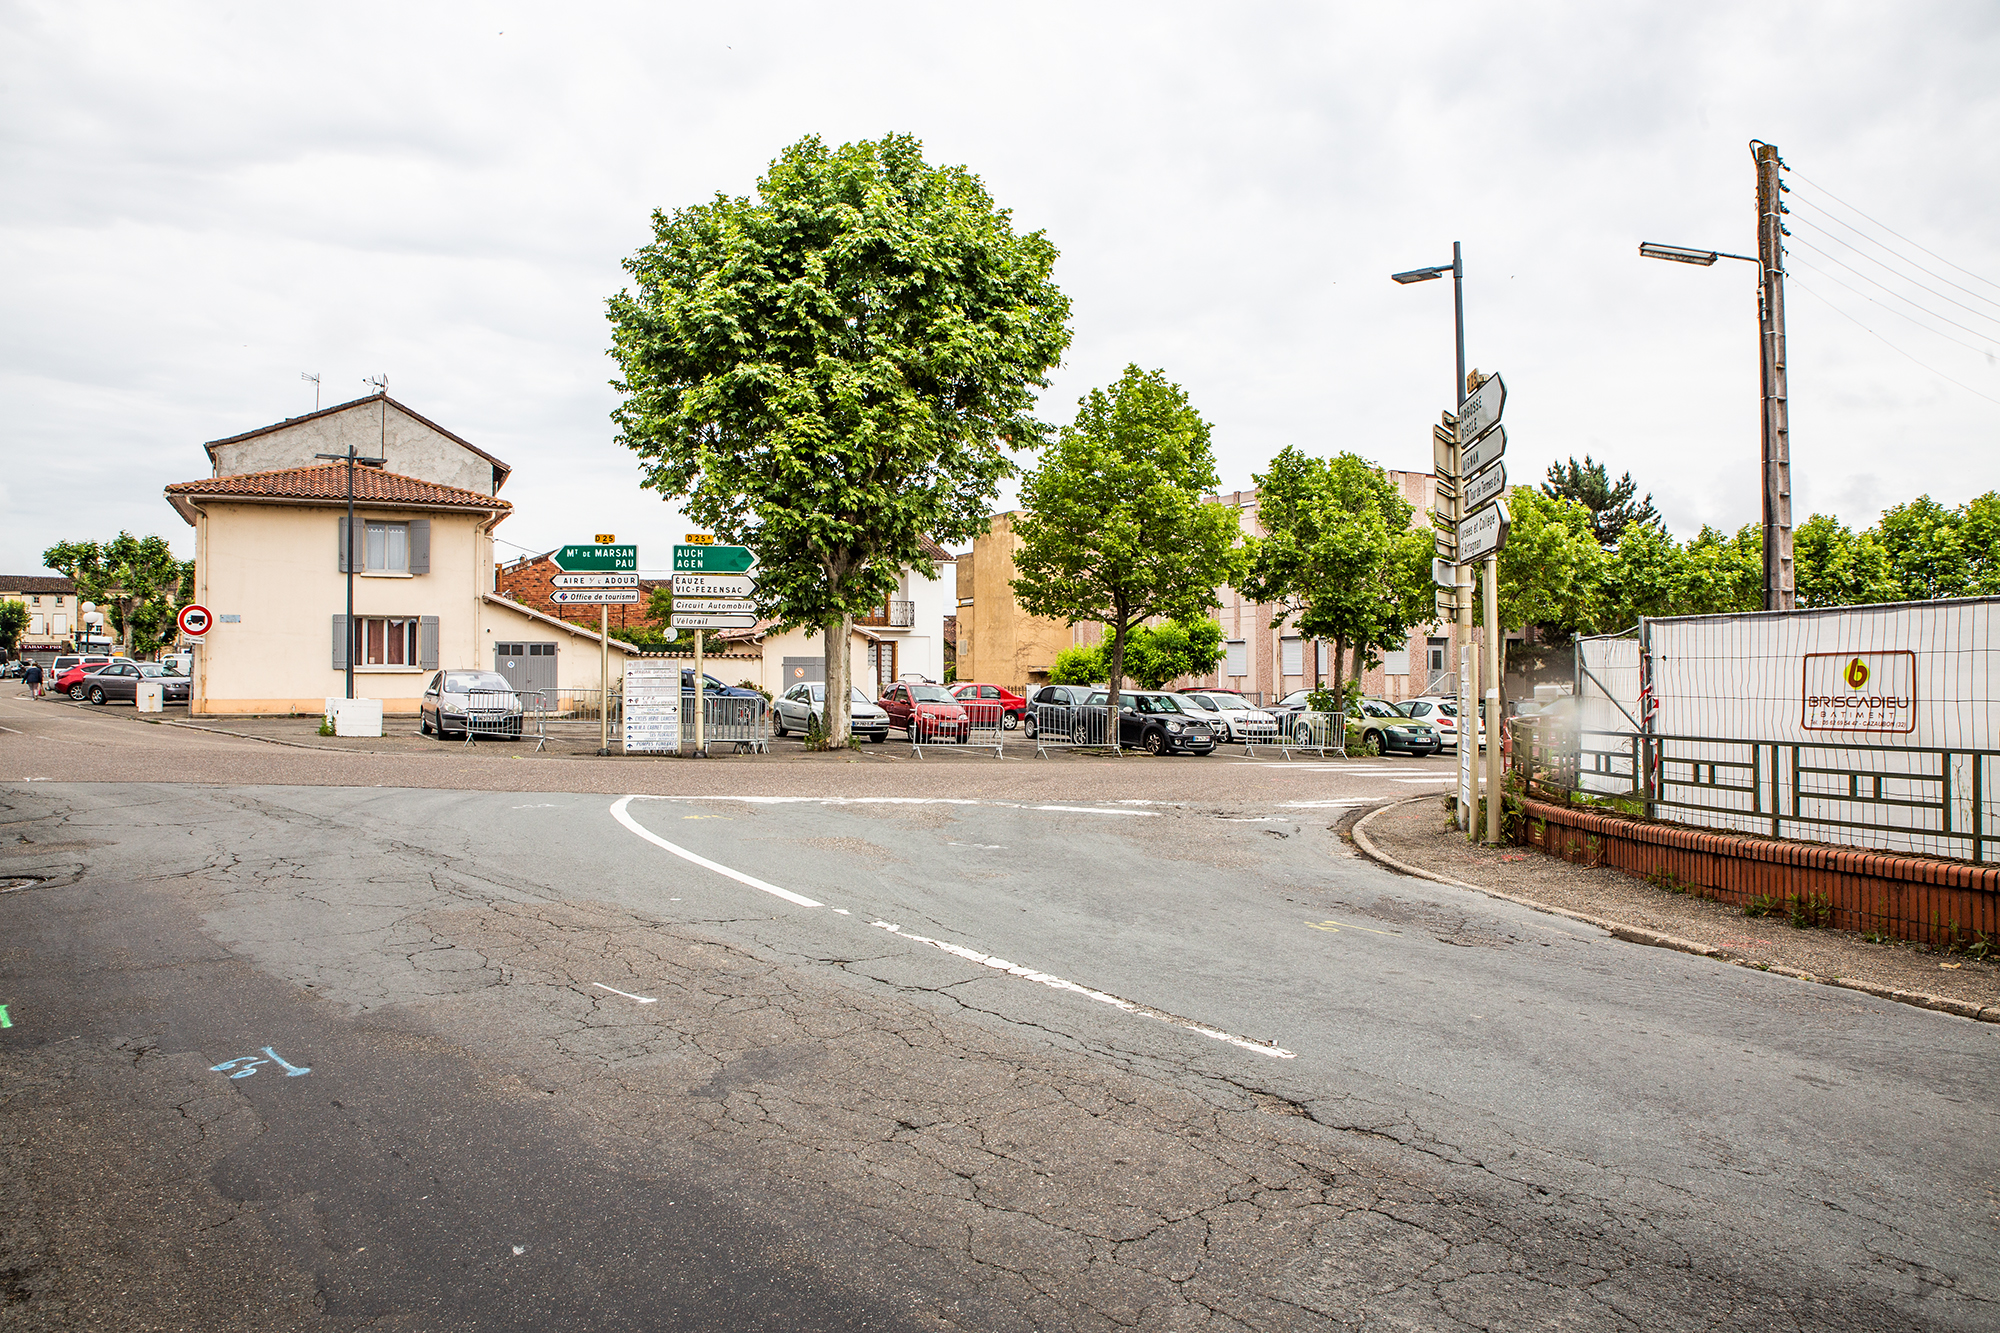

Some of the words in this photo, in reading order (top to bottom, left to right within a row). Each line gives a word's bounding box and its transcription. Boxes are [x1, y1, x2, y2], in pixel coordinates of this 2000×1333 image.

[1461, 417, 1477, 440] RISCLE
[1462, 450, 1479, 471] AIGNAN
[1473, 521, 1478, 534] et
[594, 548, 634, 558] MARSAN
[677, 549, 703, 558] AUCH
[615, 559, 634, 568] PAU
[677, 560, 703, 568] AGEN
[675, 576, 704, 585] ÉAUZE
[675, 586, 743, 594] VIC-FEZENSAC
[675, 601, 704, 609] Circuit
[707, 602, 752, 610] Automobile
[1808, 696, 1909, 709] BRISCADIEU
[1820, 710, 1895, 719] BATIMENT
